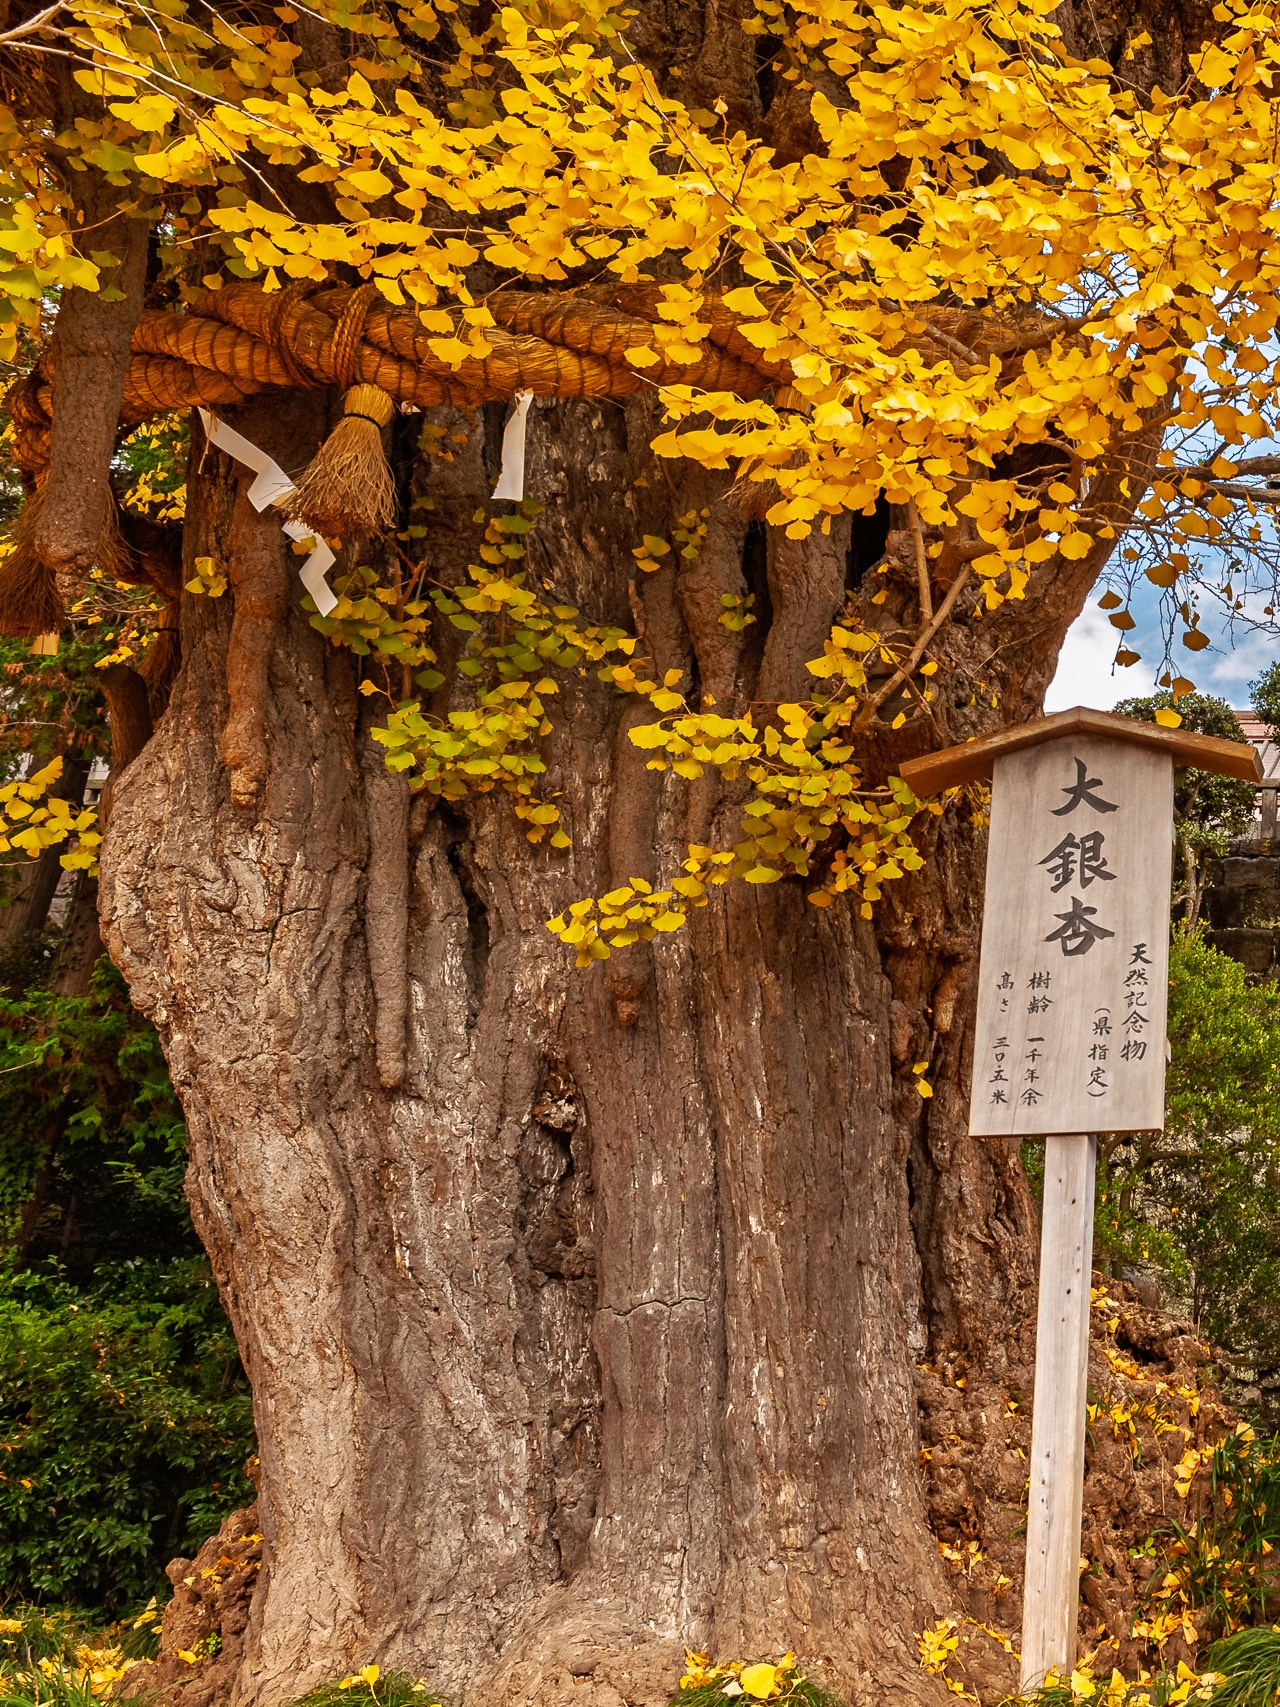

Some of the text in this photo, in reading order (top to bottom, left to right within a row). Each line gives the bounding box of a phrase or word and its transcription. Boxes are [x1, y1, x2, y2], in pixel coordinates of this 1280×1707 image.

[1036, 756, 1120, 956] 大銀杏
[1020, 971, 1054, 1106] 樹齢 一千年余
[1121, 943, 1153, 1061] 天然記念物
